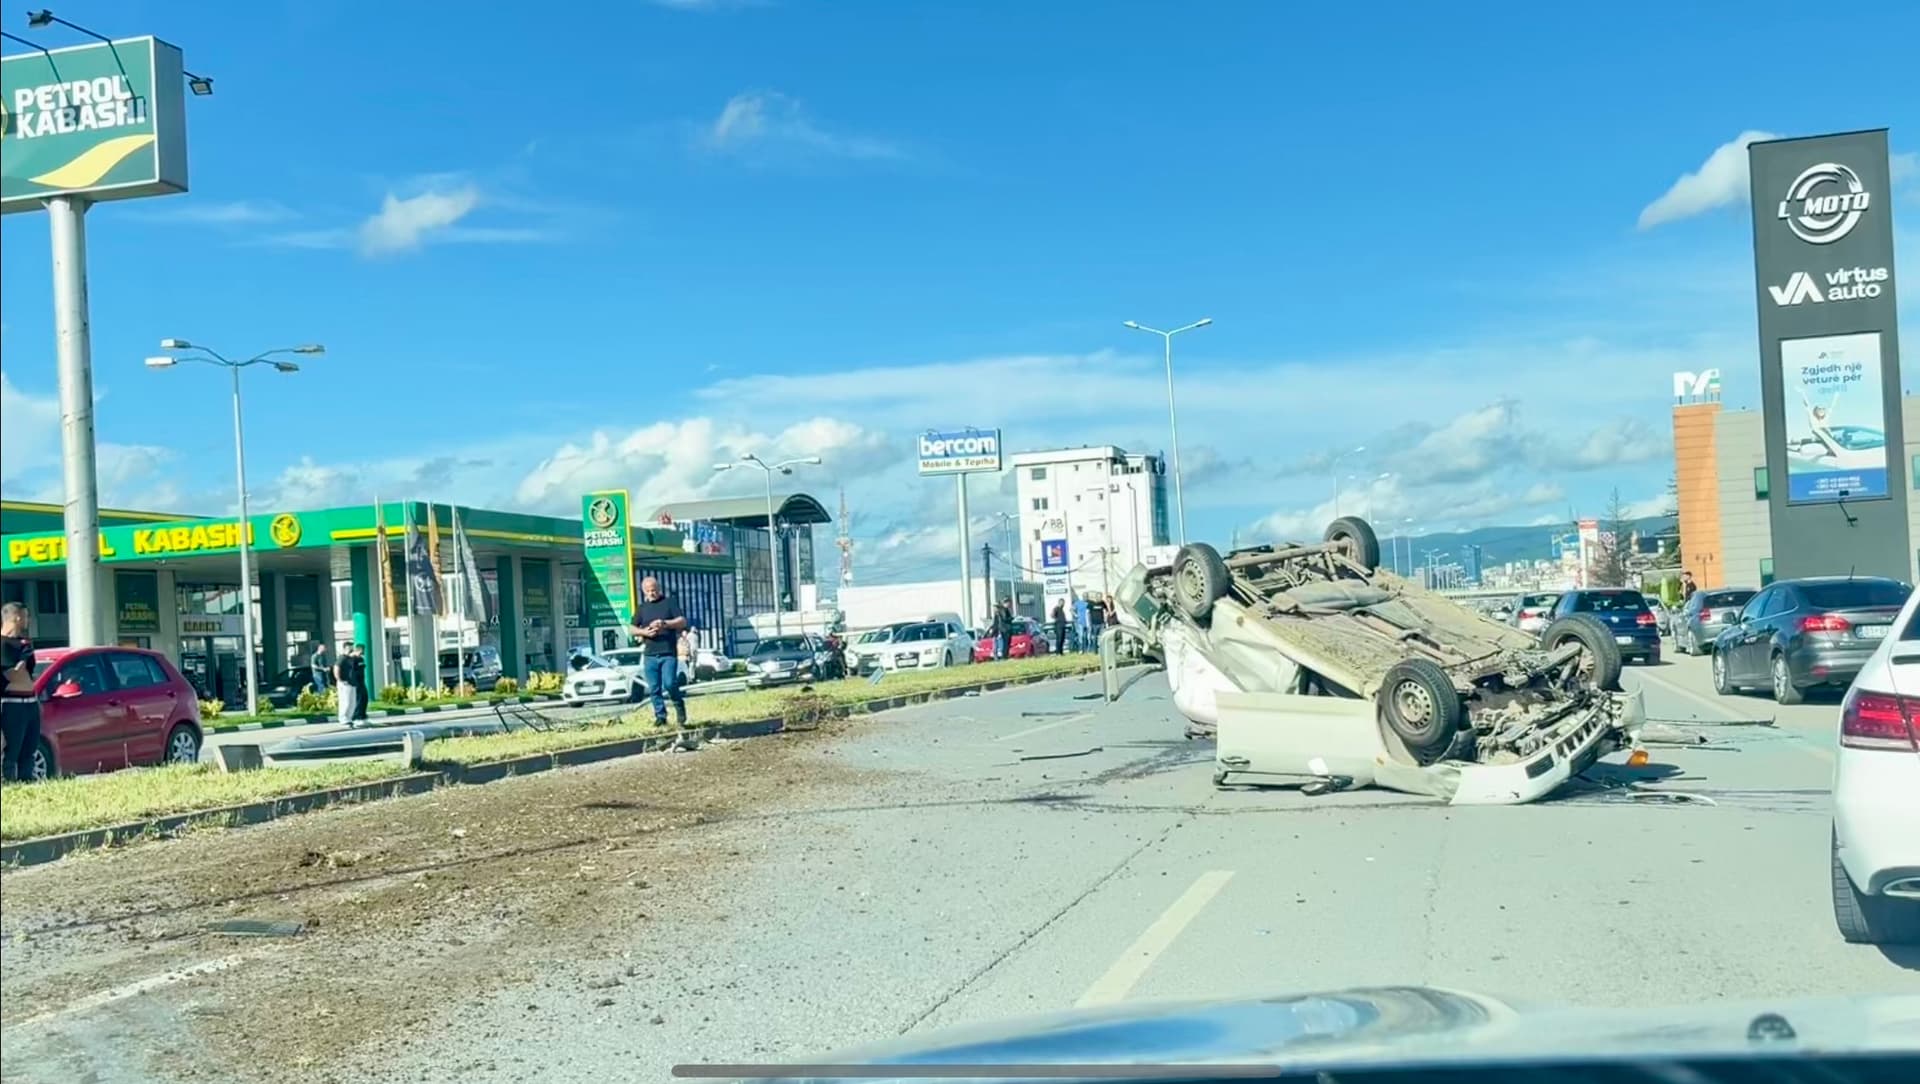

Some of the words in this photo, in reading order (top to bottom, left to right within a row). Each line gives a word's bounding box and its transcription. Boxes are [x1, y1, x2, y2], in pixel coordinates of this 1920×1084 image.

[15, 75, 131, 112] PETROL
[16, 98, 146, 139] KABASHI
[1804, 193, 1870, 215] MOTO
[1825, 267, 1889, 285] virtus
[1828, 283, 1881, 301] auto
[1802, 365, 1841, 376] Zgjedh
[920, 436, 996, 457] bercom
[9, 534, 116, 563] PETL
[133, 522, 254, 553] KABASHI
